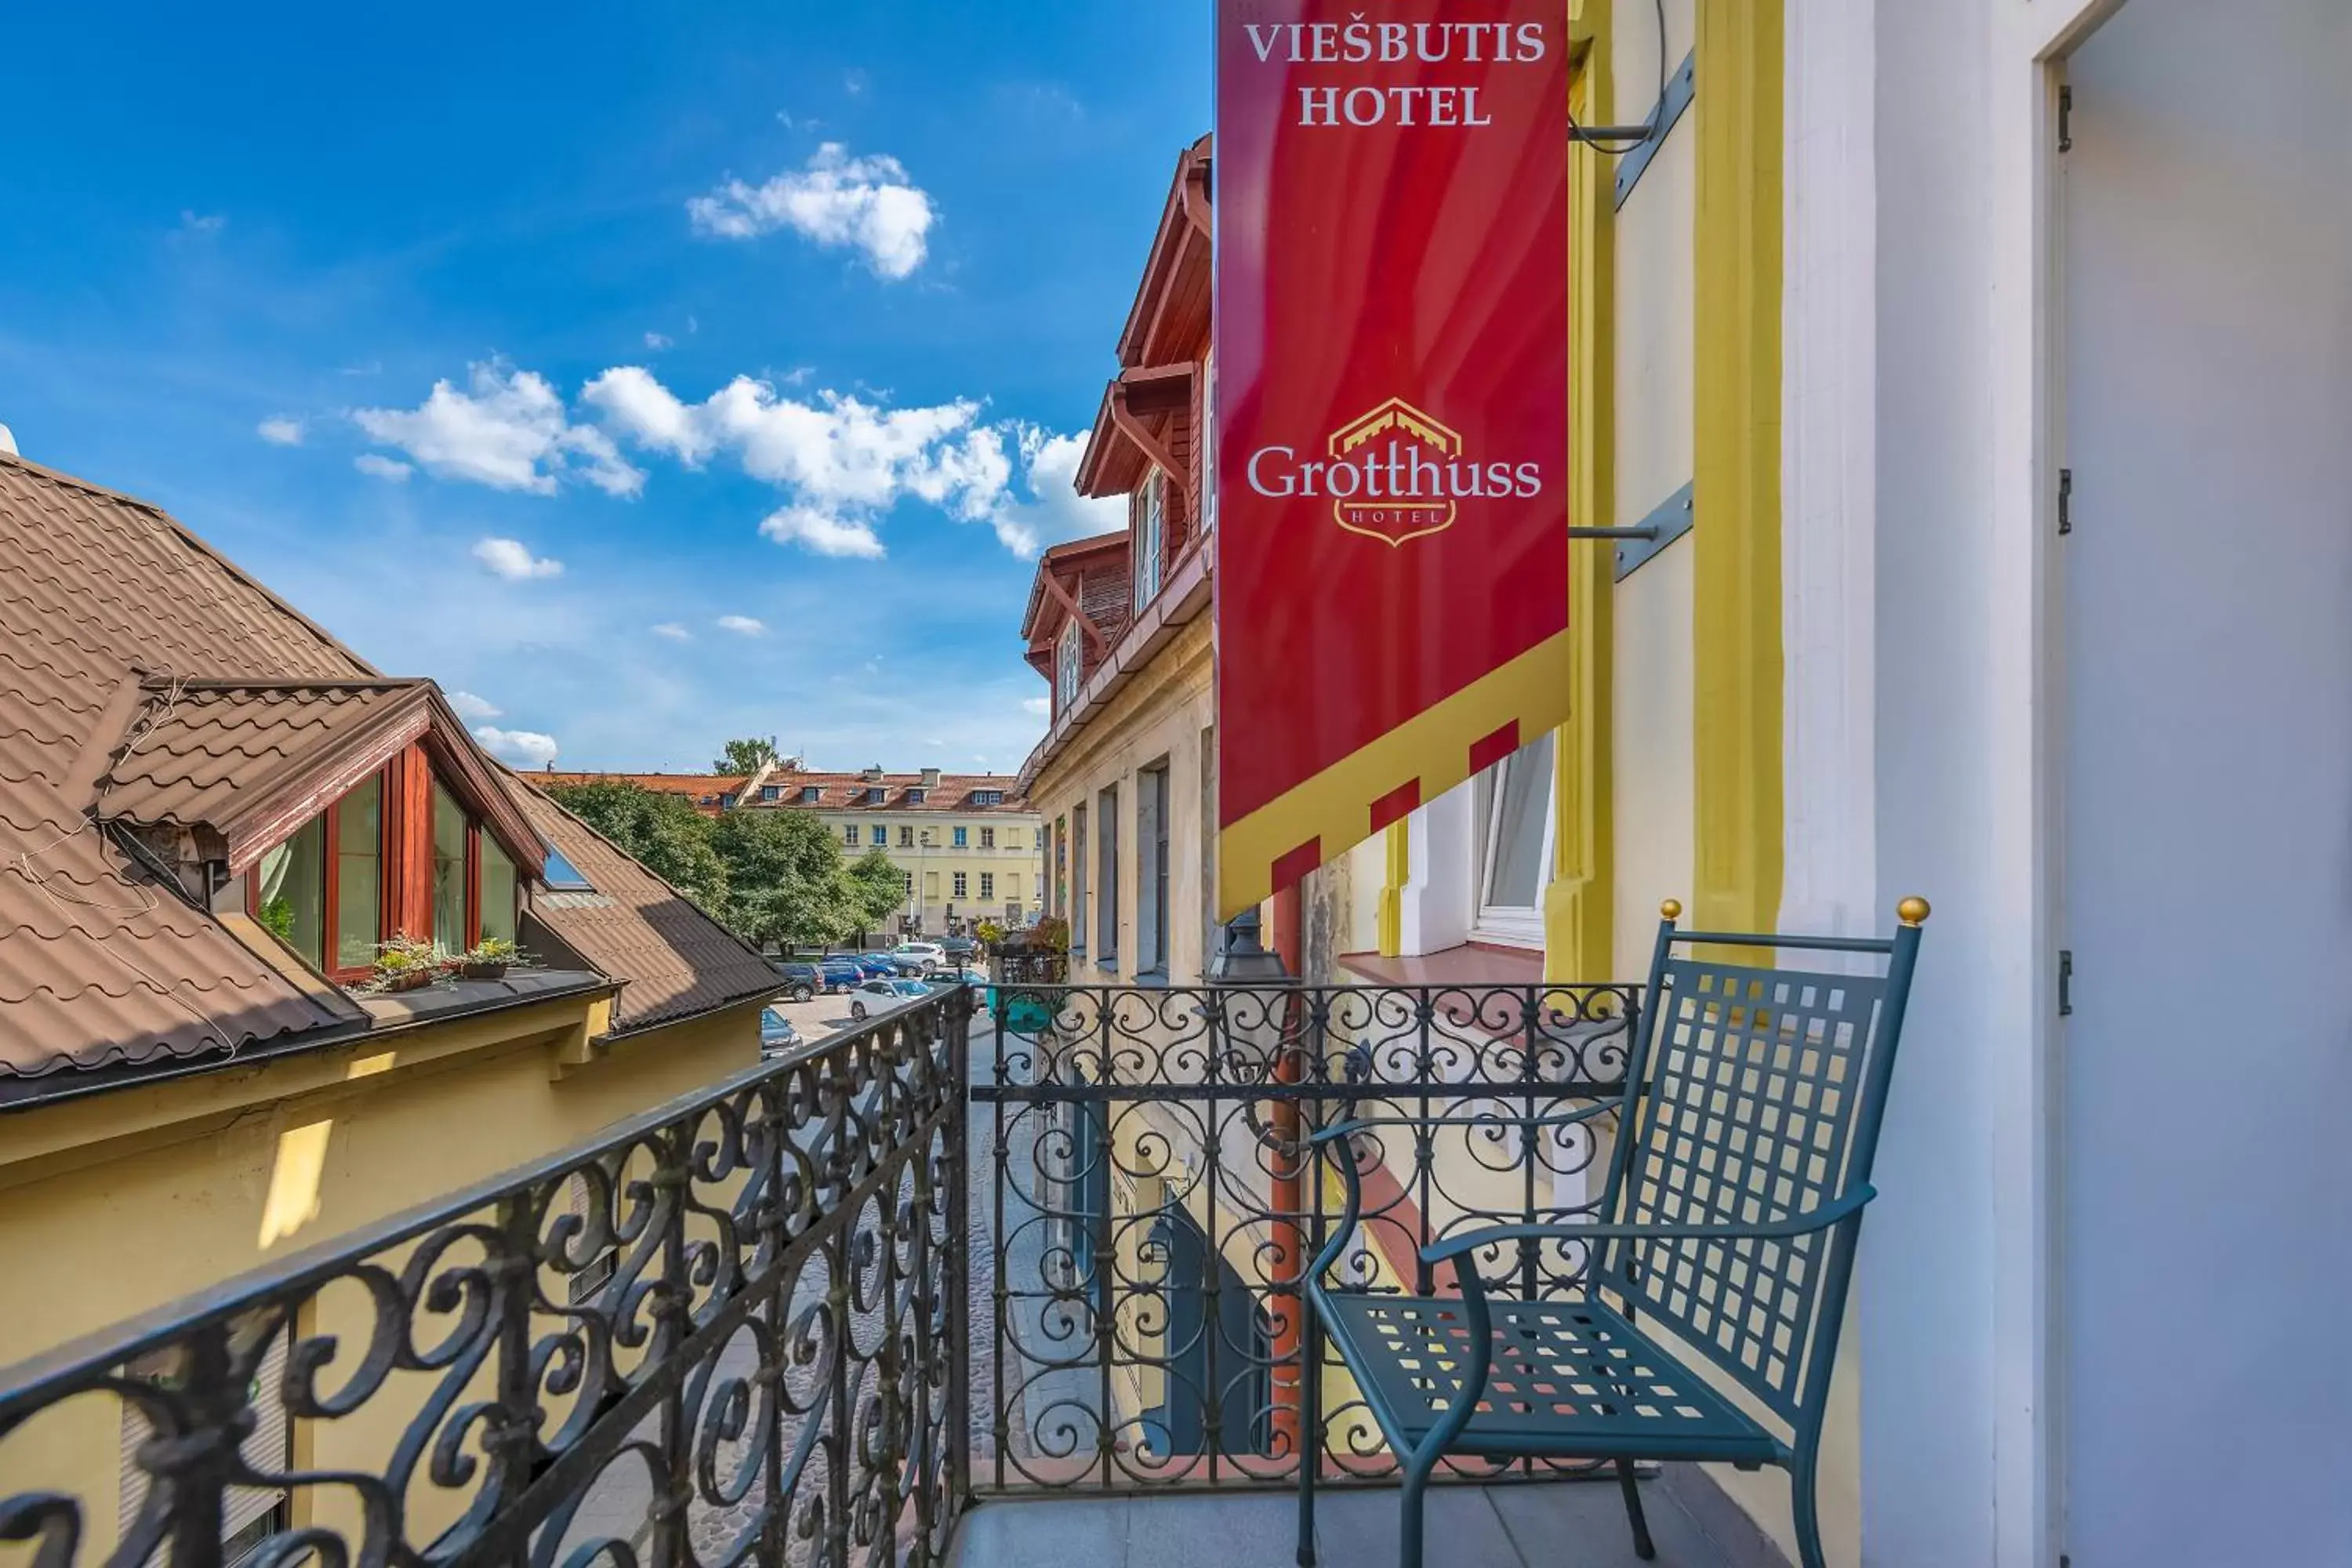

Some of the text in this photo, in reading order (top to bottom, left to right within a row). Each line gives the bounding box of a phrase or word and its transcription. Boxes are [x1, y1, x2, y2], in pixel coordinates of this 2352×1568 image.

[1243, 12, 1545, 62] VIEŠBUTIS
[1298, 87, 1491, 126] HOTEL
[1247, 440, 1542, 498] Grotthuss
[1352, 510, 1439, 523] HOTEL
